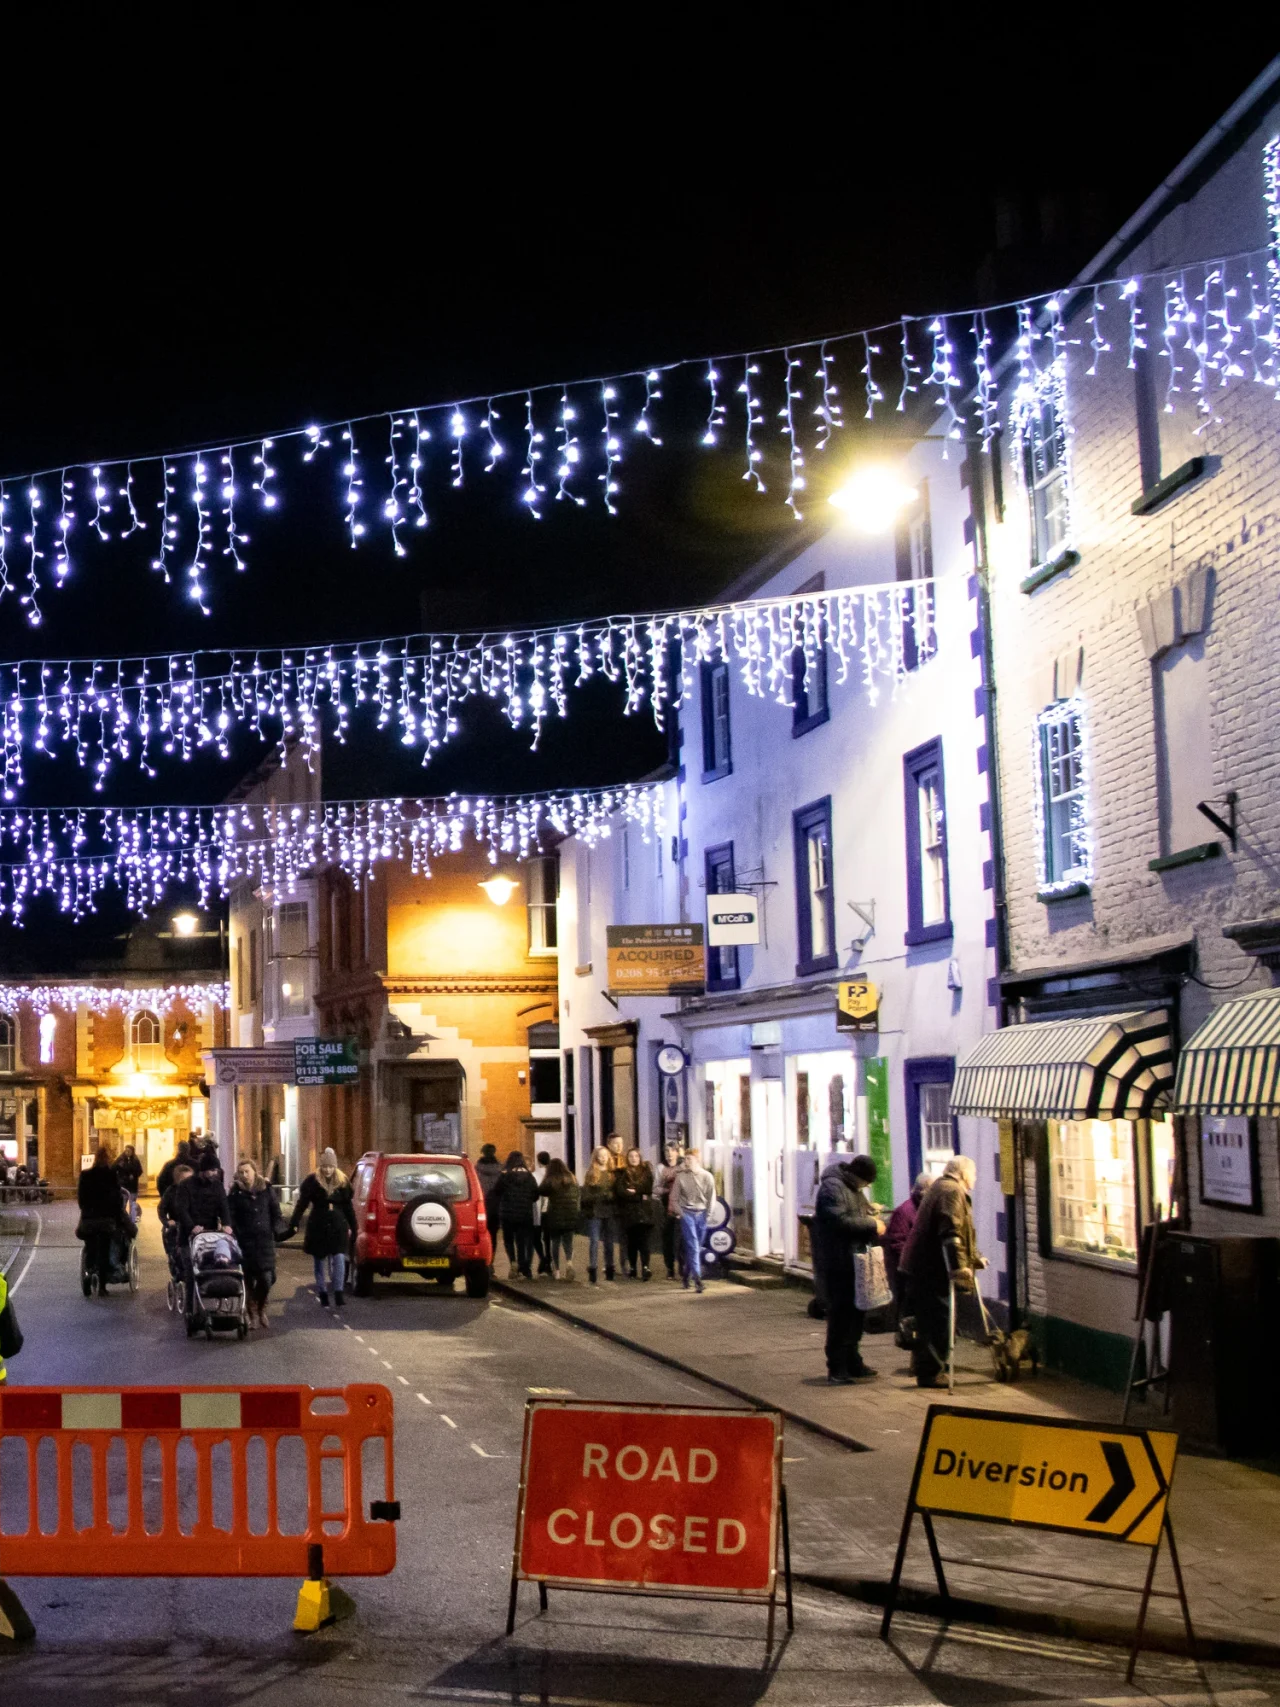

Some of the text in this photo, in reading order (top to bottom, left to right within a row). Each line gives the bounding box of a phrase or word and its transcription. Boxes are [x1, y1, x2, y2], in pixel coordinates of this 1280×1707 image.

[616, 950, 695, 963] ACQUIRED
[295, 1043, 343, 1054] FOR SALE
[296, 1066, 317, 1075] 0113
[319, 1066, 335, 1074] 394
[297, 1076, 325, 1084] CBRE
[115, 1111, 168, 1121] ALFORD
[582, 1442, 719, 1484] ROAD
[933, 1448, 1089, 1494] Diversion
[546, 1507, 748, 1556] CLOSED
